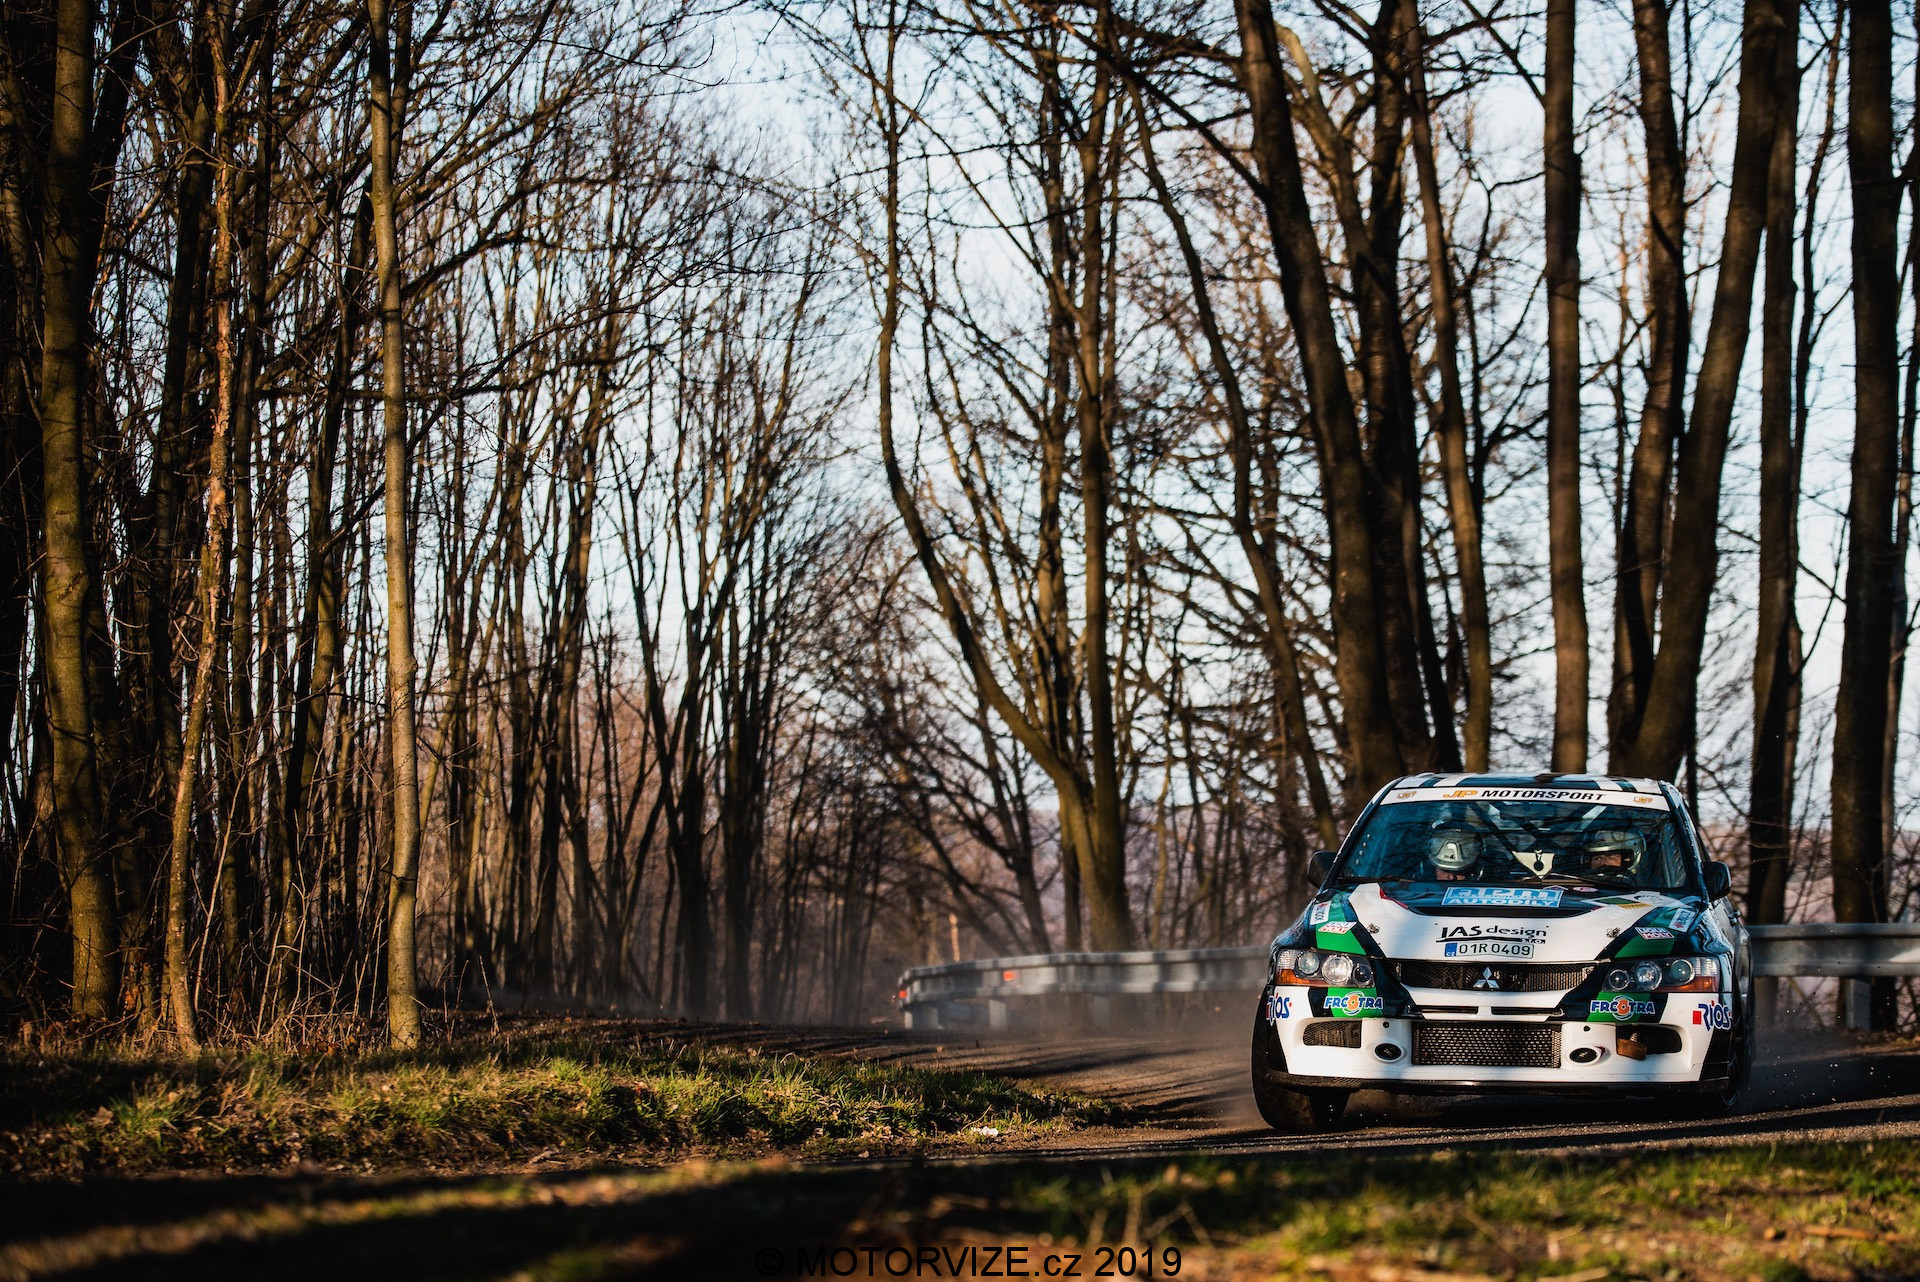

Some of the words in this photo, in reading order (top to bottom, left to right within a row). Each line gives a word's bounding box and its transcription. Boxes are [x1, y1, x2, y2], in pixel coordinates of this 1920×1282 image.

[1443, 790, 1478, 798] JP
[1481, 790, 1606, 800] MOTORSPORT
[1486, 925, 1547, 939] design
[1459, 943, 1488, 954] 01R
[1491, 943, 1531, 956] 0409
